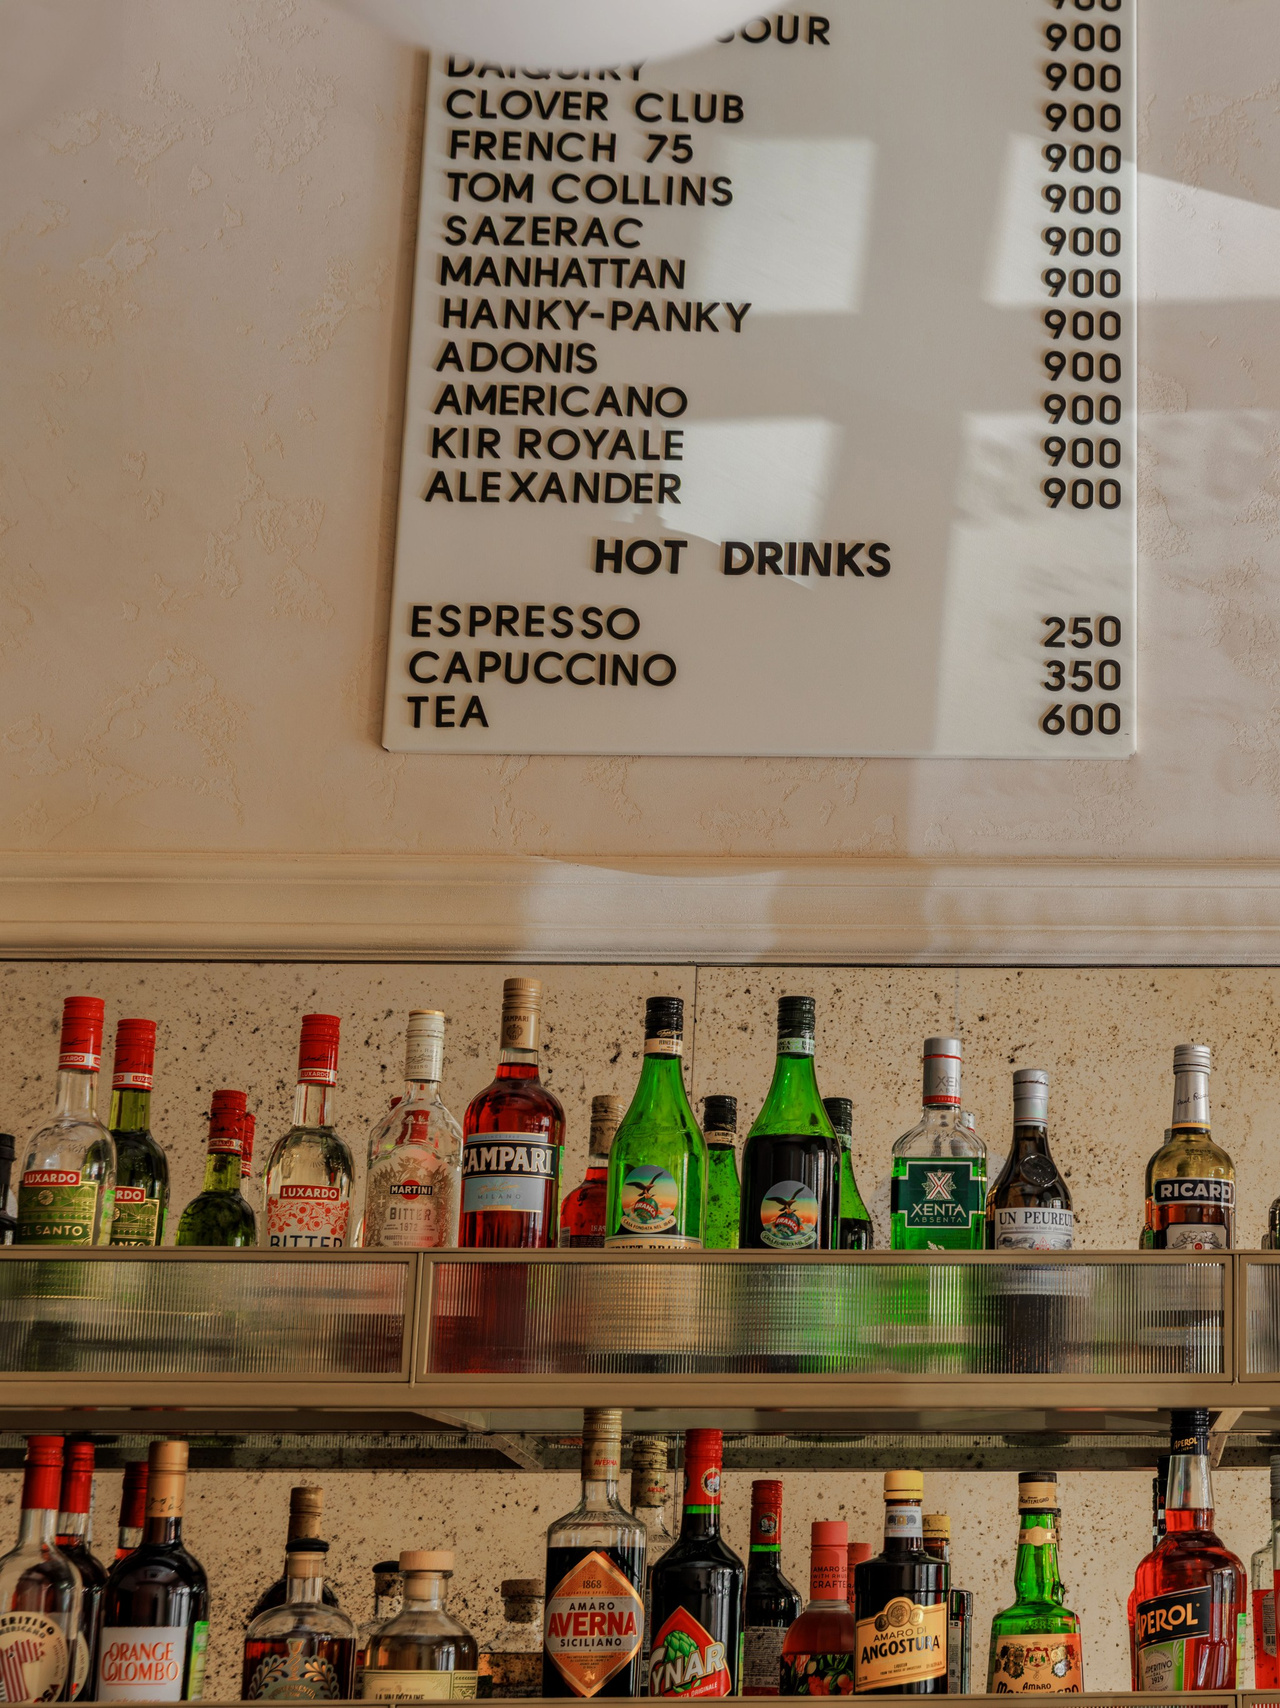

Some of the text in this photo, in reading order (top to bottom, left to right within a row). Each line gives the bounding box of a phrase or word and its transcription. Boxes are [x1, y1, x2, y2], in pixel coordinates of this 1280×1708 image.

[715, 15, 830, 46] OUR
[1045, 23, 1121, 53] 900
[1045, 63, 1121, 93] 900
[446, 89, 744, 124] CLOVER CLUB
[1045, 103, 1121, 133] 900
[449, 130, 694, 164] FRENCH 75
[1045, 143, 1121, 174] 900
[447, 172, 733, 207] TOM COLLINS
[1045, 184, 1121, 215] 900
[444, 215, 643, 249] SAZERAC
[1044, 227, 1121, 257] 900
[440, 256, 686, 290] MANHATTAN
[1044, 268, 1121, 299] 900
[442, 298, 752, 333] HANKY-PANKY
[1044, 309, 1121, 341] 900
[435, 341, 598, 375] ADONIS
[1044, 351, 1121, 384] 900
[433, 384, 688, 418] AMERICANO
[1043, 394, 1121, 426] 900
[431, 427, 684, 461] KIR ROYALE
[1043, 436, 1121, 469] 900
[424, 470, 682, 504] ALEXANDER
[1043, 477, 1121, 510] 900
[594, 539, 891, 578] HOT DRINKS
[410, 604, 640, 640] ESPRESSO
[1043, 616, 1121, 649] 250
[408, 650, 677, 687] CAPUCCINO
[1043, 659, 1121, 692] 350
[407, 695, 489, 729] TEA
[1042, 703, 1121, 736] 600
[461, 1146, 554, 1175] CAMPARI
[24, 1173, 77, 1184] LUXARDO
[282, 1187, 339, 1200] LUXARDO
[391, 1185, 432, 1195] MARTINI
[1160, 1183, 1232, 1199] RICARD
[389, 1207, 432, 1221] BITTER
[910, 1203, 967, 1217] XENTA
[999, 1211, 1017, 1225] UN
[22, 1225, 84, 1237] EL SANTO
[400, 1222, 418, 1232] 1872
[1173, 1437, 1198, 1449] APEROL
[582, 1580, 602, 1589] 1868
[569, 1602, 615, 1611] AMARO
[547, 1611, 638, 1638] AVERNA
[873, 1626, 927, 1642] AMARO DI
[110, 1642, 175, 1661] ORANGE
[560, 1638, 623, 1648] SICILIANO
[860, 1635, 940, 1665] ANGOSTURA
[102, 1650, 179, 1682] COLOMBO
[1022, 1682, 1052, 1691] AMARO
